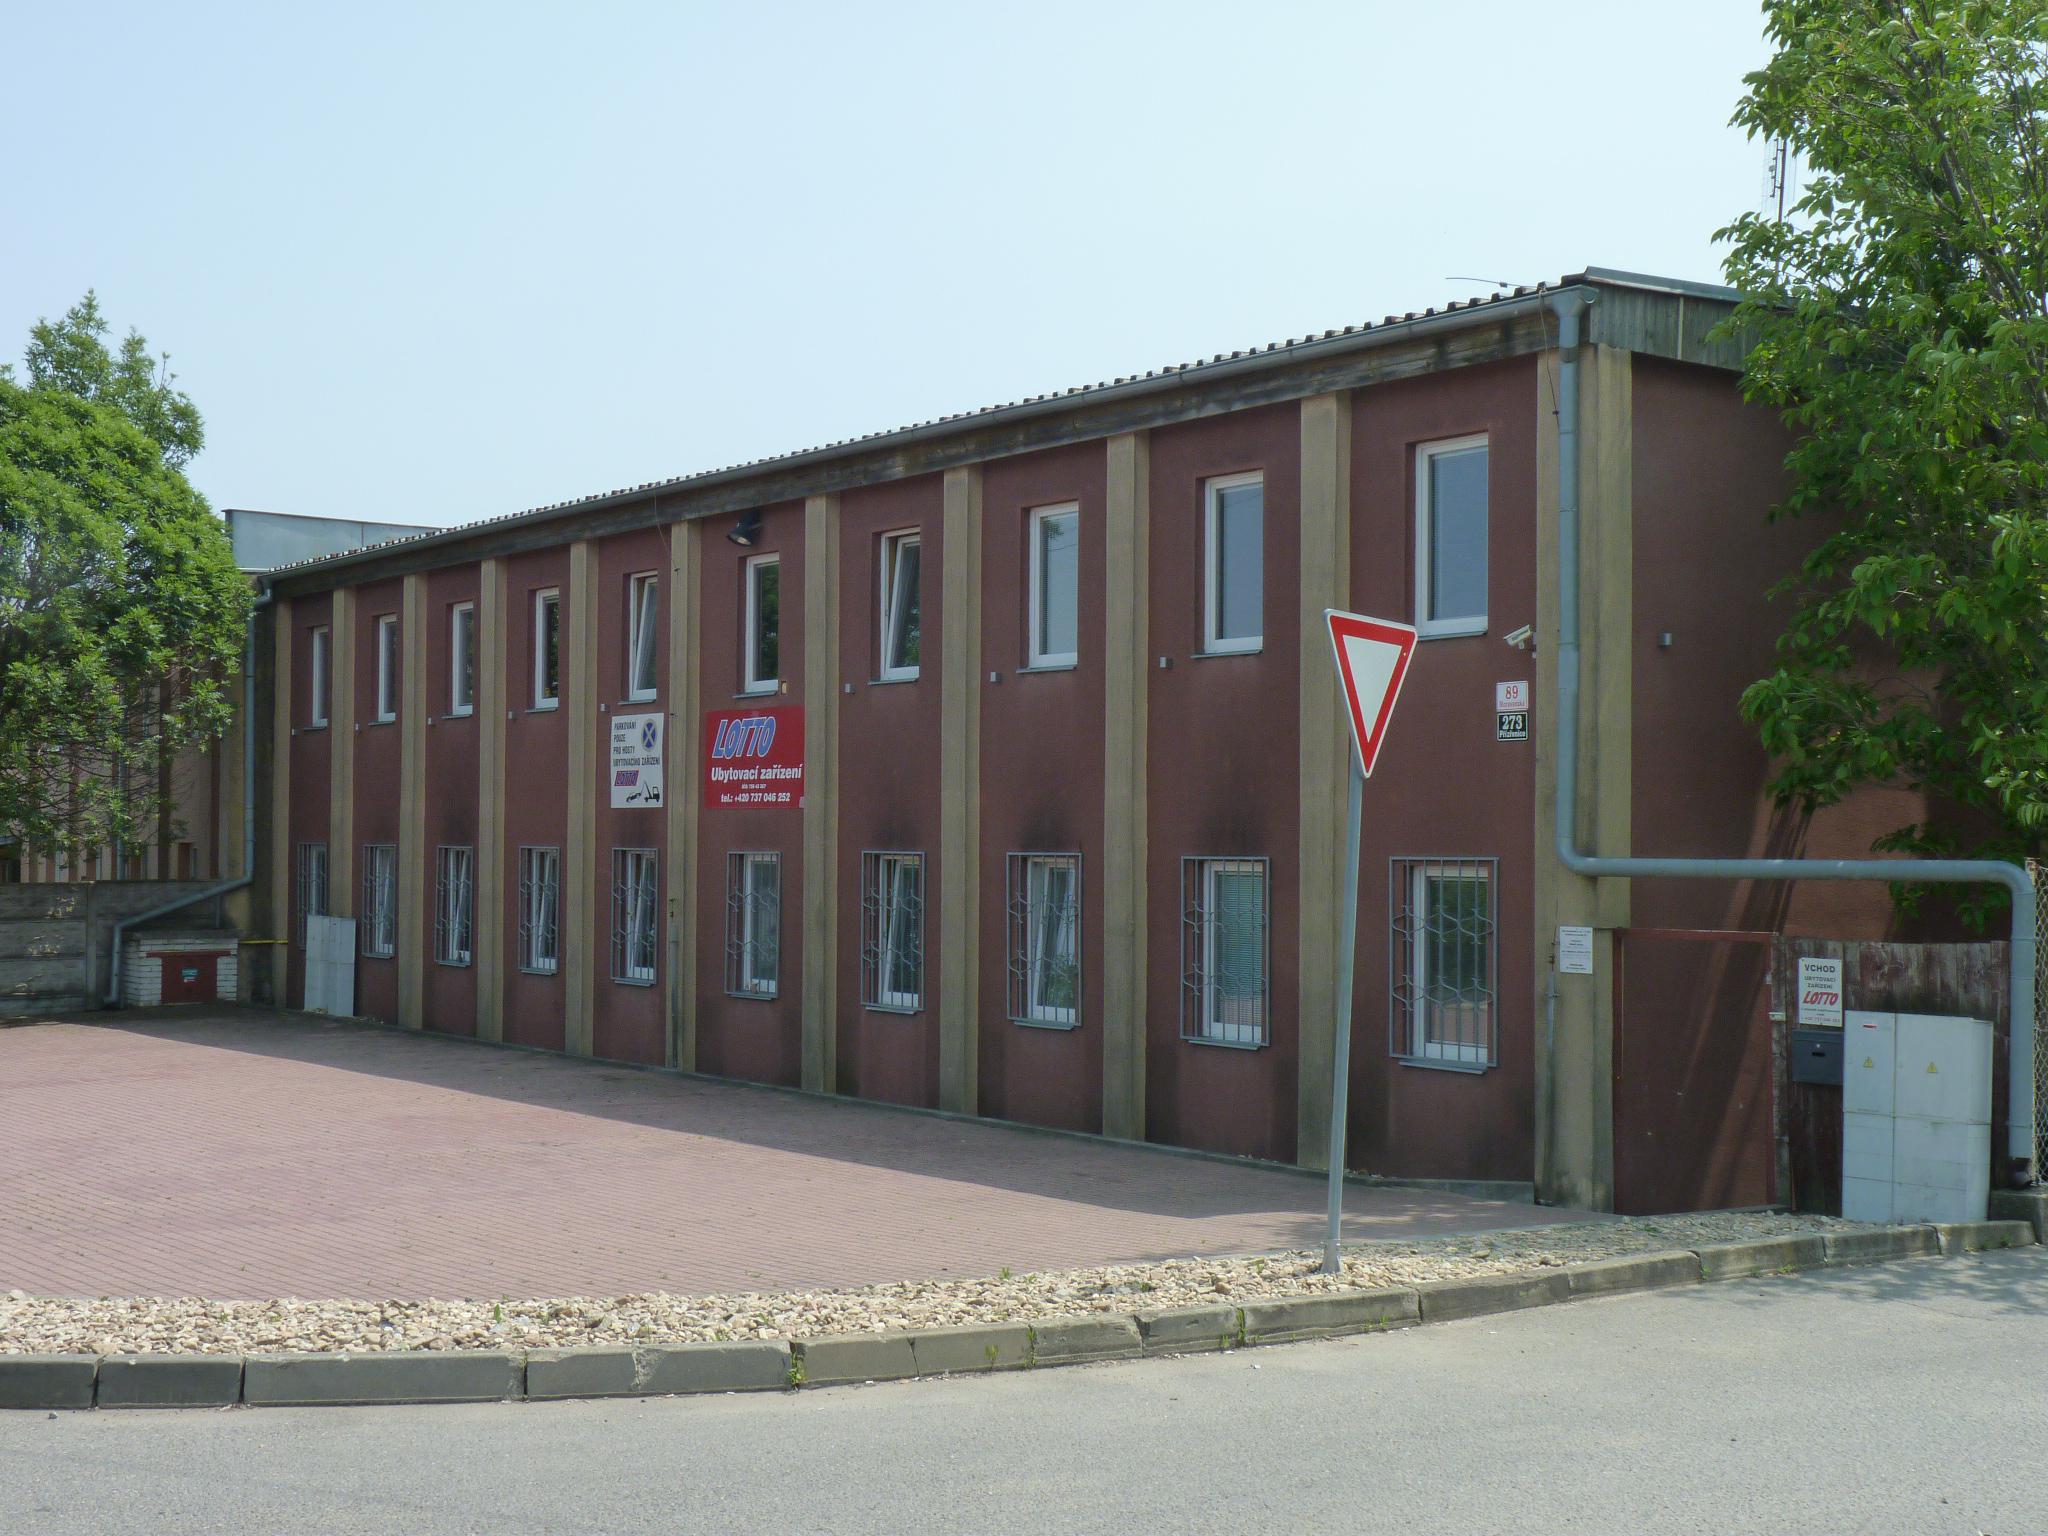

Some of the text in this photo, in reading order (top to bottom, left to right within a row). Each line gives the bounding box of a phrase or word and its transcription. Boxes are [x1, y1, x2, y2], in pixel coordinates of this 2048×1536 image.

[1505, 685, 1519, 699] 89
[1502, 715, 1523, 730] 273
[711, 716, 777, 760] LOTTO
[622, 746, 636, 754] HOSTY
[711, 764, 804, 783] Ubytovací zařízení
[734, 793, 750, 802] +420
[750, 793, 762, 802] 737
[763, 793, 777, 802] 046
[777, 793, 791, 802] 252
[1804, 964, 1836, 973] VCHOD
[1802, 991, 1839, 1006] LOTTO
